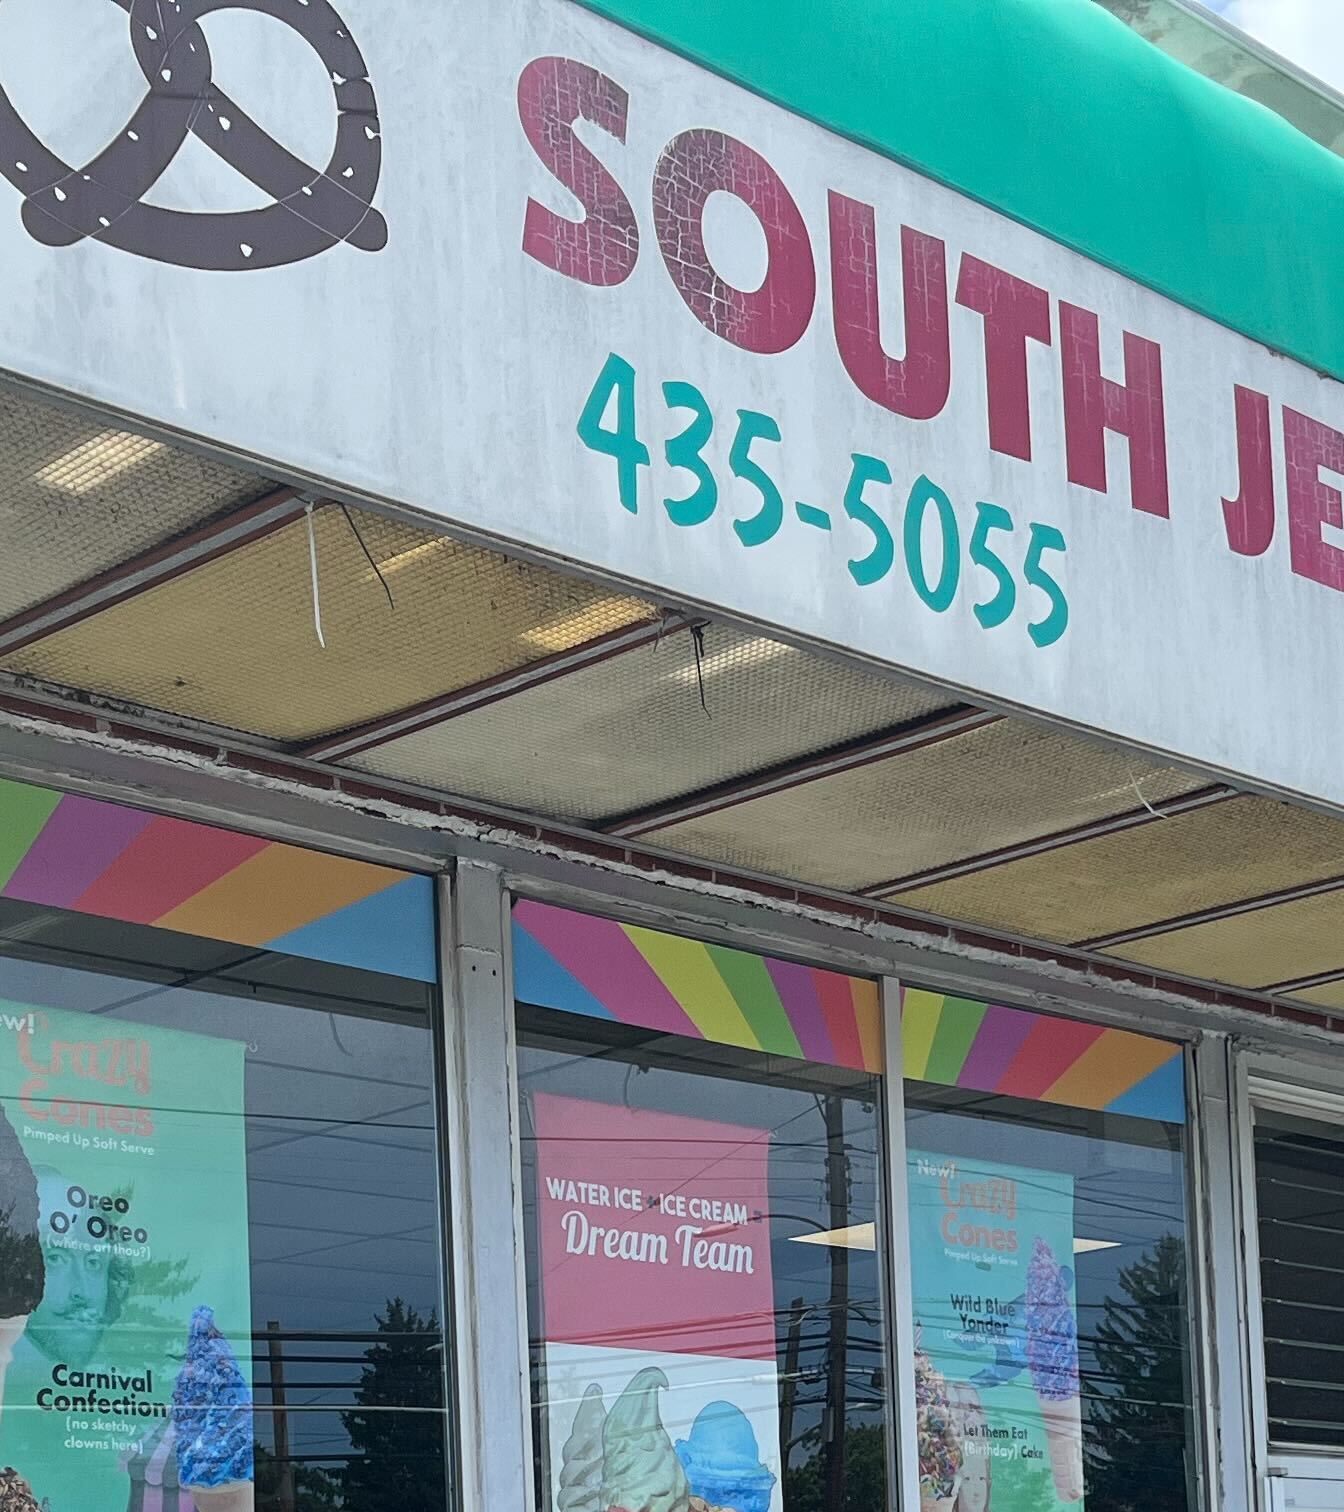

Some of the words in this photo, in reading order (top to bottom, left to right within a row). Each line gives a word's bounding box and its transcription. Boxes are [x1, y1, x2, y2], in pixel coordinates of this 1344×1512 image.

[518, 56, 1170, 520] SOUTH
[577, 353, 1069, 647] 435-5055
[19, 1078, 155, 1136] Cones
[23, 1126, 70, 1145] Pimped
[73, 1133, 90, 1150] Up
[93, 1136, 118, 1152] Soft
[121, 1140, 155, 1156] Serve
[917, 1159, 956, 1180] New!
[66, 1185, 130, 1214] Oreo
[546, 1177, 611, 1208] WATER
[614, 1187, 642, 1211] ICE
[659, 1193, 686, 1217] ICE
[689, 1198, 748, 1226] CREAM
[86, 1215, 148, 1243] Oreo
[561, 1210, 668, 1264] Dream
[675, 1225, 754, 1274] Team
[941, 1212, 1018, 1253] Cones
[950, 1293, 981, 1313] Wild
[986, 1298, 1015, 1317] Blue
[959, 1312, 1008, 1336] Yonder
[51, 1364, 153, 1393] Carnival
[36, 1388, 167, 1418] Confection
[92, 1418, 137, 1435] sketchy
[963, 1424, 978, 1437] Let
[981, 1424, 1009, 1439] Them
[1011, 1427, 1028, 1440] Eat
[64, 1436, 109, 1450] clowns
[1020, 1445, 1044, 1459] Cake
